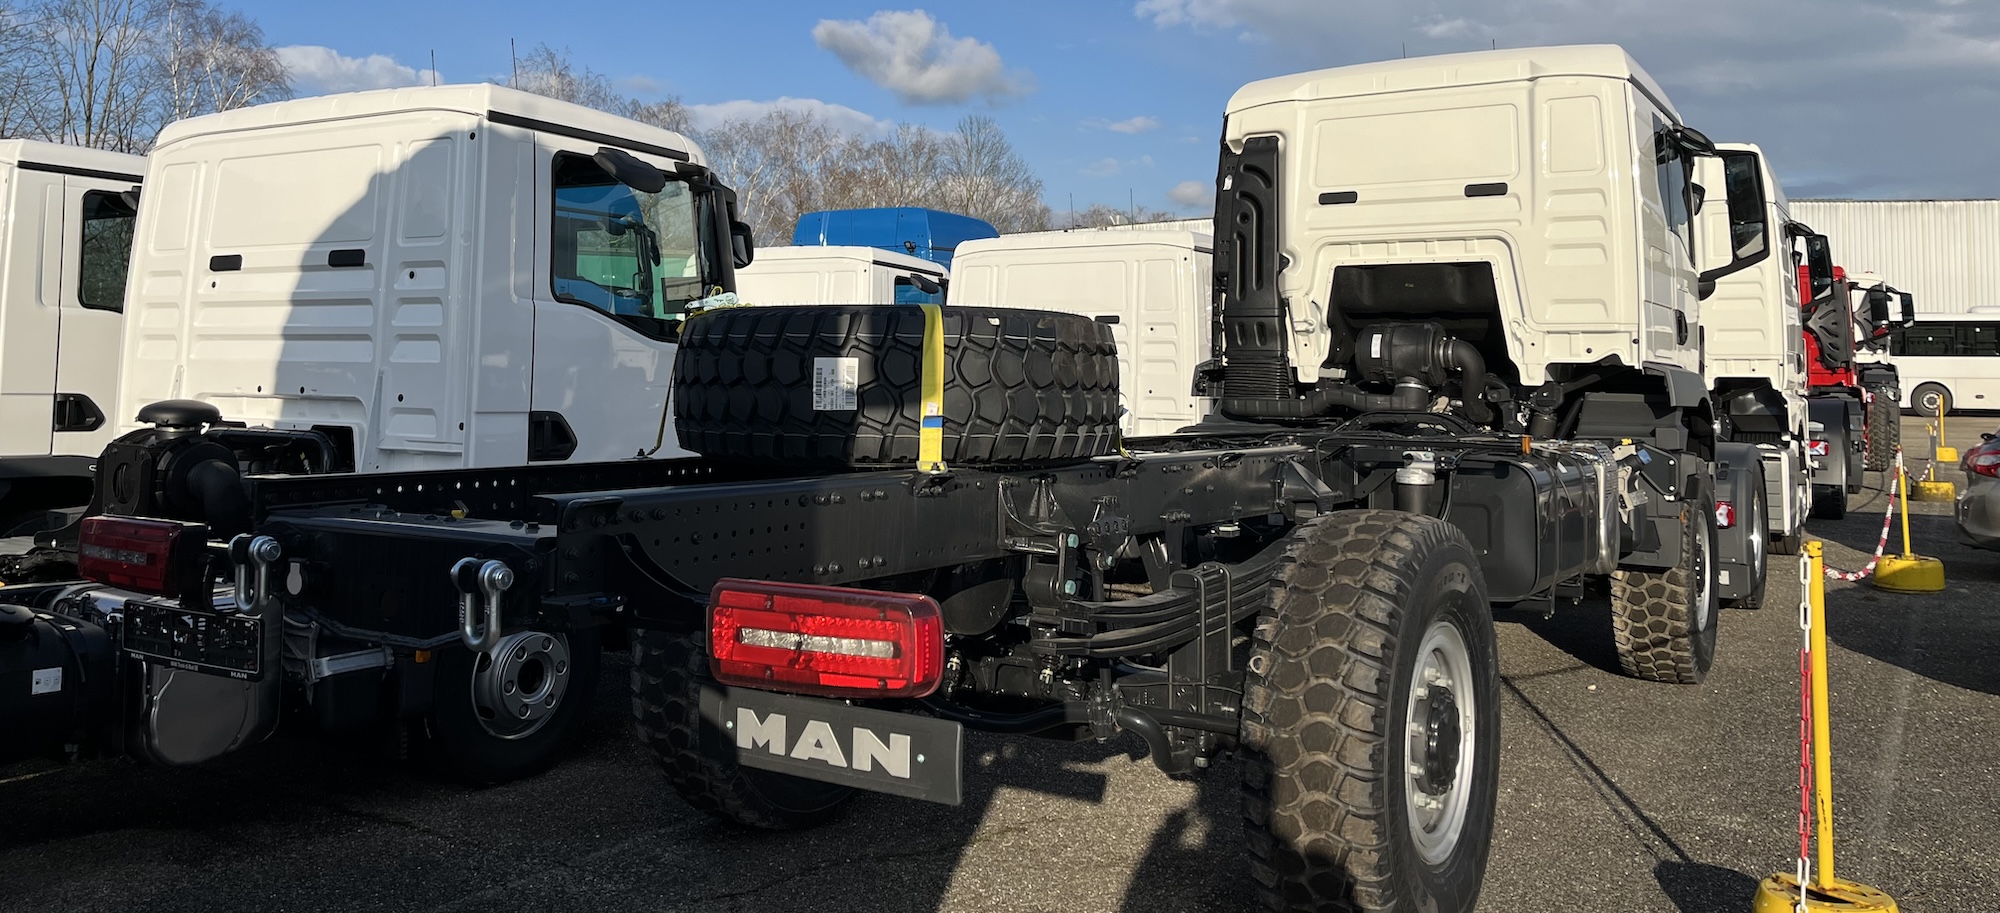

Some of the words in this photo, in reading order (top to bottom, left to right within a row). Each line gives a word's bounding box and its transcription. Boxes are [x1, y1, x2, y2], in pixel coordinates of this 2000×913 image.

[131, 652, 144, 660] MAN
[230, 671, 247, 679] MAN
[736, 707, 911, 778] MAN
